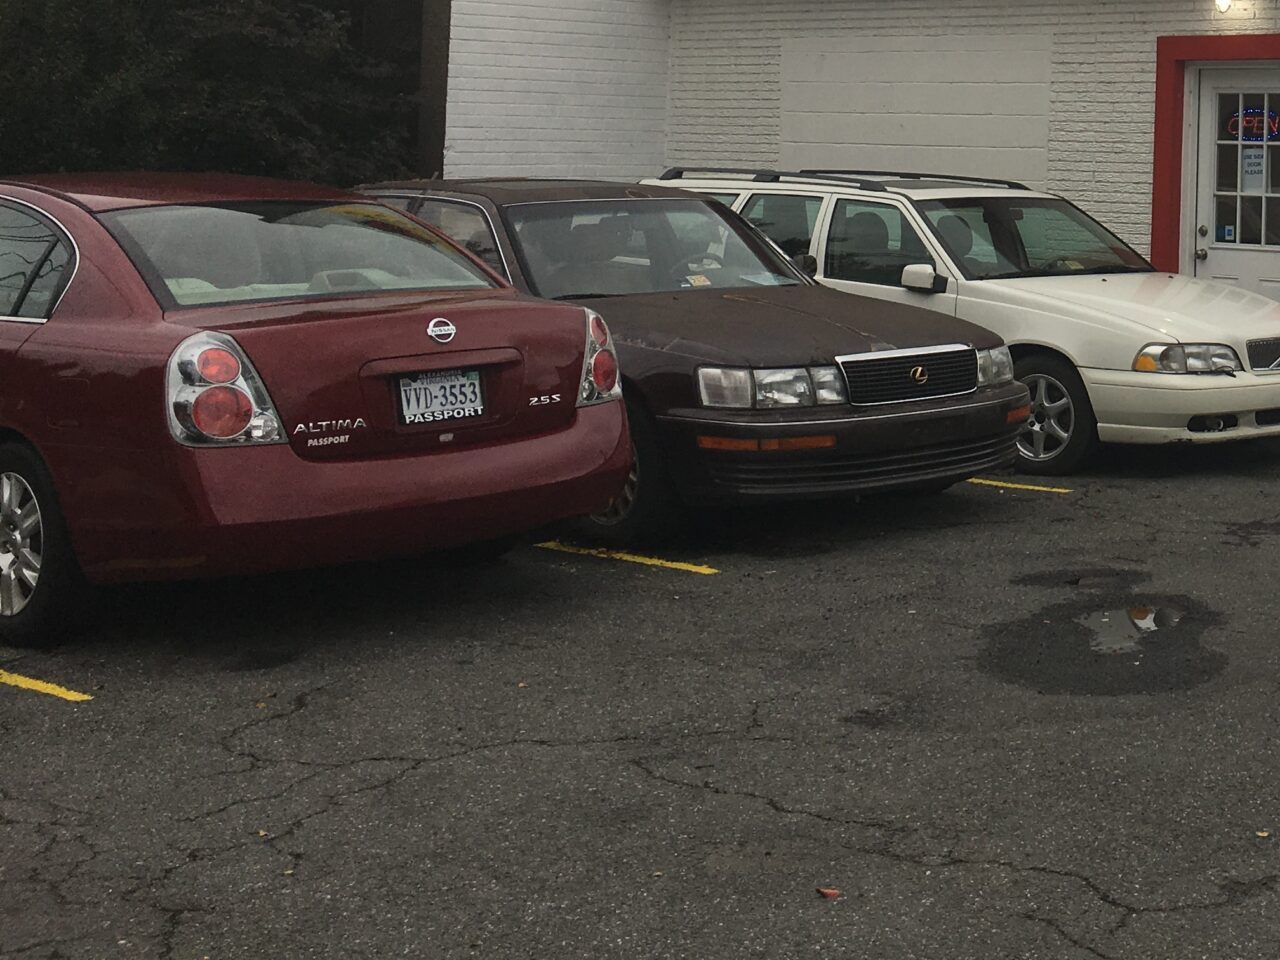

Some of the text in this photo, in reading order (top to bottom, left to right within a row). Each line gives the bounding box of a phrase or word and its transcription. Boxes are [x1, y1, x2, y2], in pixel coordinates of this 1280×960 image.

[1228, 116, 1279, 134] OPEN
[431, 326, 455, 334] NISSAN
[403, 382, 478, 411] VVD-3553
[405, 406, 483, 424] PASSPORT
[293, 418, 367, 435] ALTIMA
[307, 435, 350, 447] PASSPORT
